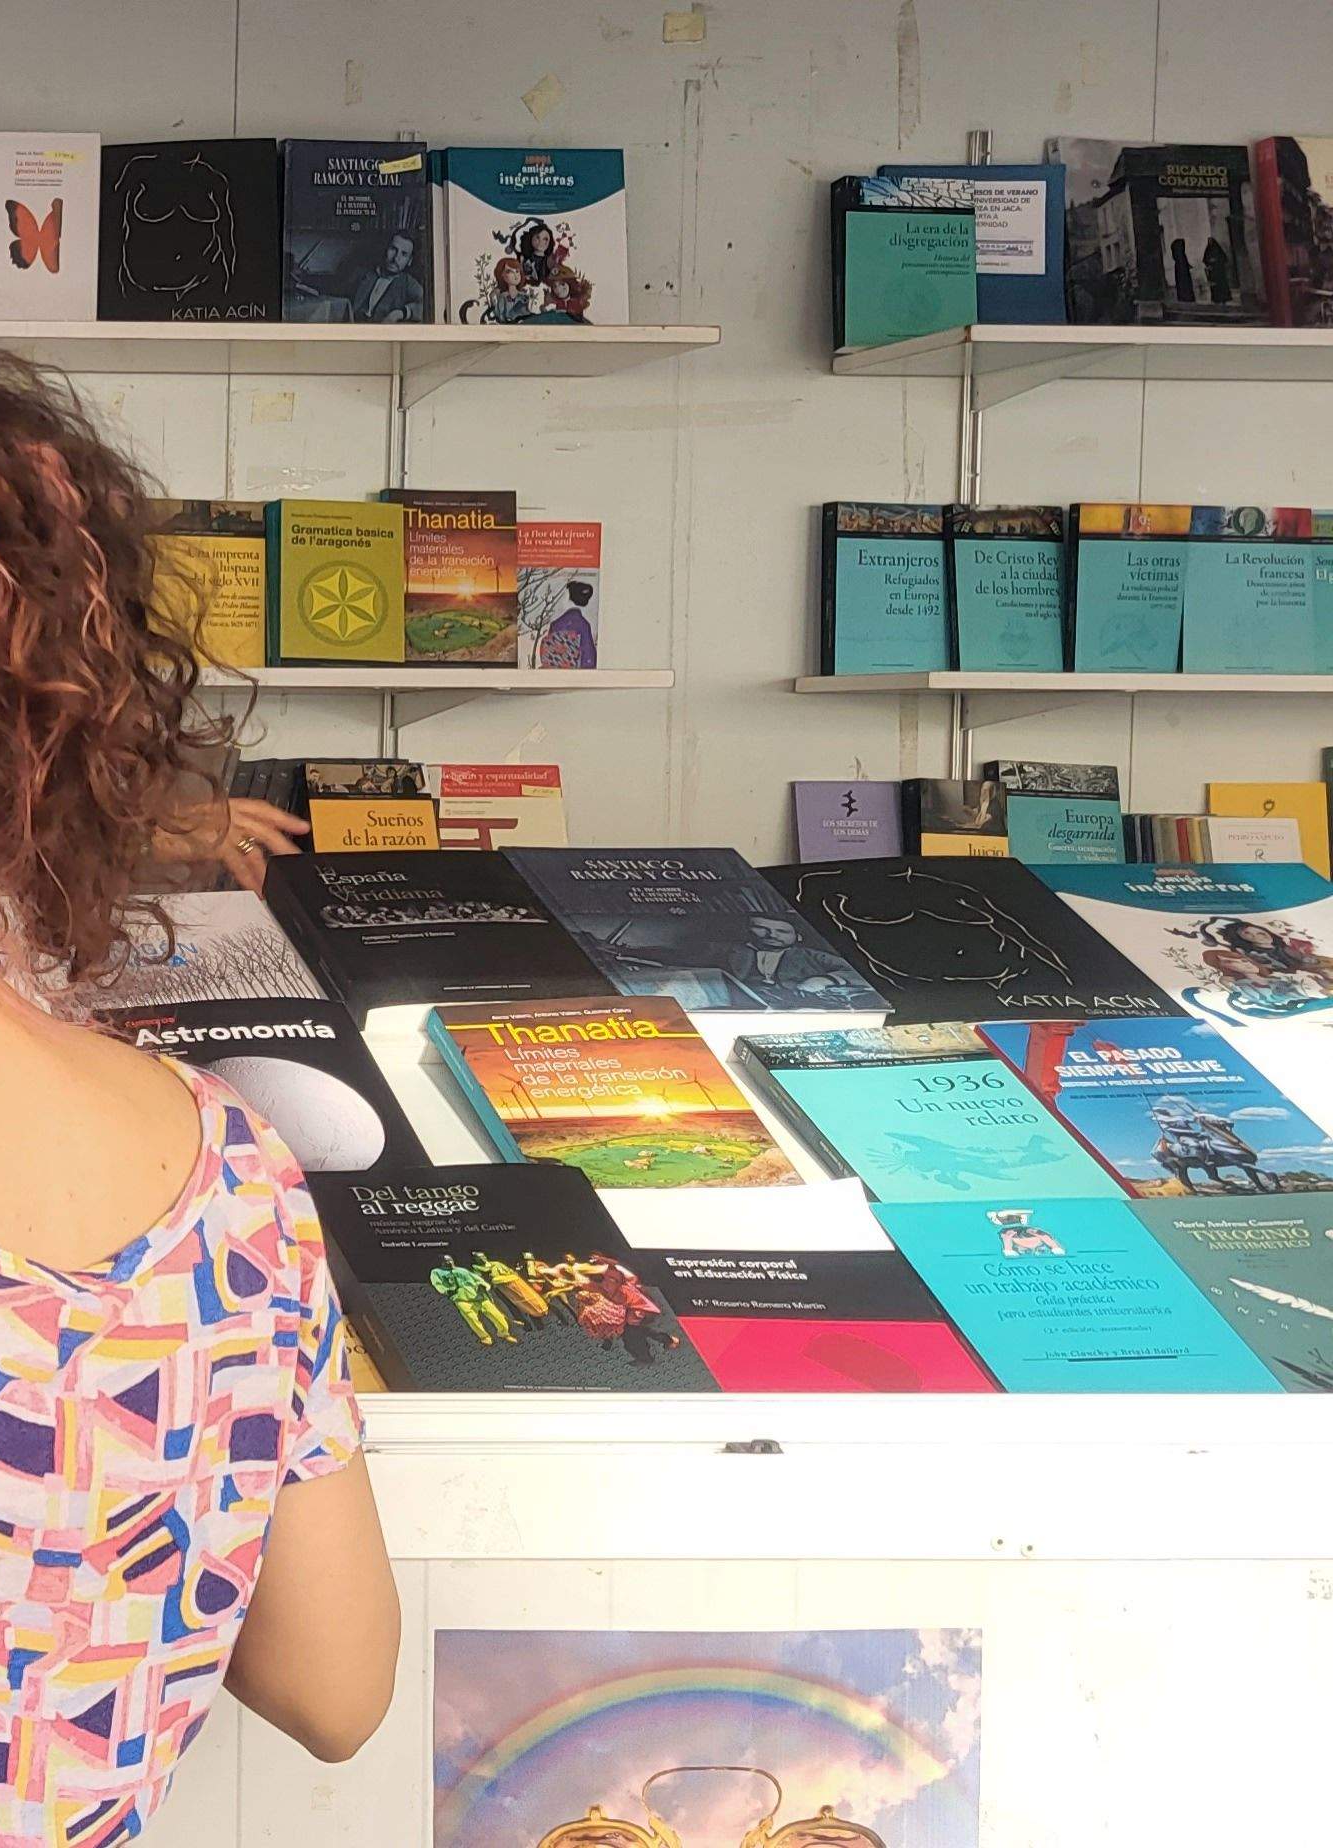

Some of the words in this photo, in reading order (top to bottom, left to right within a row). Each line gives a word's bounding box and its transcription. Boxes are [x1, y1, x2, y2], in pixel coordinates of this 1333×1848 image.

[314, 171, 354, 185] RAMÓN
[358, 173, 363, 185] Y
[368, 173, 401, 186] CAJAL
[1166, 165, 1227, 176] RICARDO
[500, 172, 574, 191] ingenieras
[889, 234, 968, 251] disgregación
[171, 305, 222, 321] KATIA
[224, 302, 267, 319] ACÍN
[404, 508, 495, 530] Thanatia
[291, 524, 353, 538] Gramatica
[409, 532, 446, 543] Límites
[213, 549, 260, 563] imprenta
[409, 544, 464, 554] materiales
[409, 555, 423, 565] de
[428, 555, 438, 565] la
[441, 554, 494, 566] transición
[858, 549, 939, 572] Extranjeros
[974, 551, 993, 565] De
[996, 551, 1033, 565] Cristo
[1127, 552, 1149, 567] Las
[1152, 554, 1181, 567] otras
[1225, 553, 1239, 565] La
[1243, 553, 1304, 565] Revolución
[219, 562, 260, 575] hispana
[1130, 568, 1179, 581] víctimas
[1259, 567, 1305, 579] francesa
[884, 574, 940, 588] Refugiados
[367, 810, 424, 828] Sueños
[1065, 808, 1114, 829] Europa
[342, 828, 361, 846] de
[365, 829, 378, 846] la
[383, 831, 426, 846] razón
[1047, 823, 1116, 845] desgarrada
[585, 860, 683, 870] SANTIAGO
[320, 871, 408, 885] España
[570, 869, 643, 880] RAMÓN
[646, 870, 657, 880] Y
[662, 870, 722, 880] CAJAL
[329, 888, 444, 902] Viridiana
[1124, 882, 1255, 896] ingenieras
[997, 995, 1086, 1007] KATIA
[1094, 993, 1160, 1009] ACÍN
[135, 1019, 336, 1047] Astronomía
[486, 1017, 659, 1046] Thanatia
[504, 1047, 581, 1061] Límites
[1067, 1051, 1098, 1063] EL
[1097, 1047, 1182, 1063] PASADO
[514, 1057, 621, 1073] materiales
[1053, 1063, 1147, 1078] SIEMPRE
[1145, 1059, 1226, 1074] VUELVE
[523, 1073, 553, 1086] de
[559, 1072, 577, 1084] la
[584, 1067, 687, 1082] transición
[913, 1071, 1005, 1094] 1936
[530, 1083, 642, 1099] energética
[894, 1096, 943, 1114] Un
[946, 1094, 1024, 1112] nuevo
[965, 1108, 1039, 1128] relato
[349, 1185, 397, 1201] Del
[403, 1184, 479, 1200] tango
[361, 1200, 389, 1215] al
[391, 1199, 480, 1217] reggae
[1187, 1227, 1310, 1241] TYROCINIO
[665, 1257, 736, 1269] Expresión
[738, 1259, 797, 1270] corporal
[983, 1262, 1040, 1277] Cómo
[1045, 1264, 1066, 1274] se
[1067, 1260, 1114, 1274] hace
[674, 1270, 692, 1278] en
[694, 1269, 765, 1279] Educación
[767, 1270, 808, 1281] Física
[964, 1283, 992, 1294] un
[993, 1278, 1058, 1296] trabajo
[1061, 1275, 1159, 1291] académico
